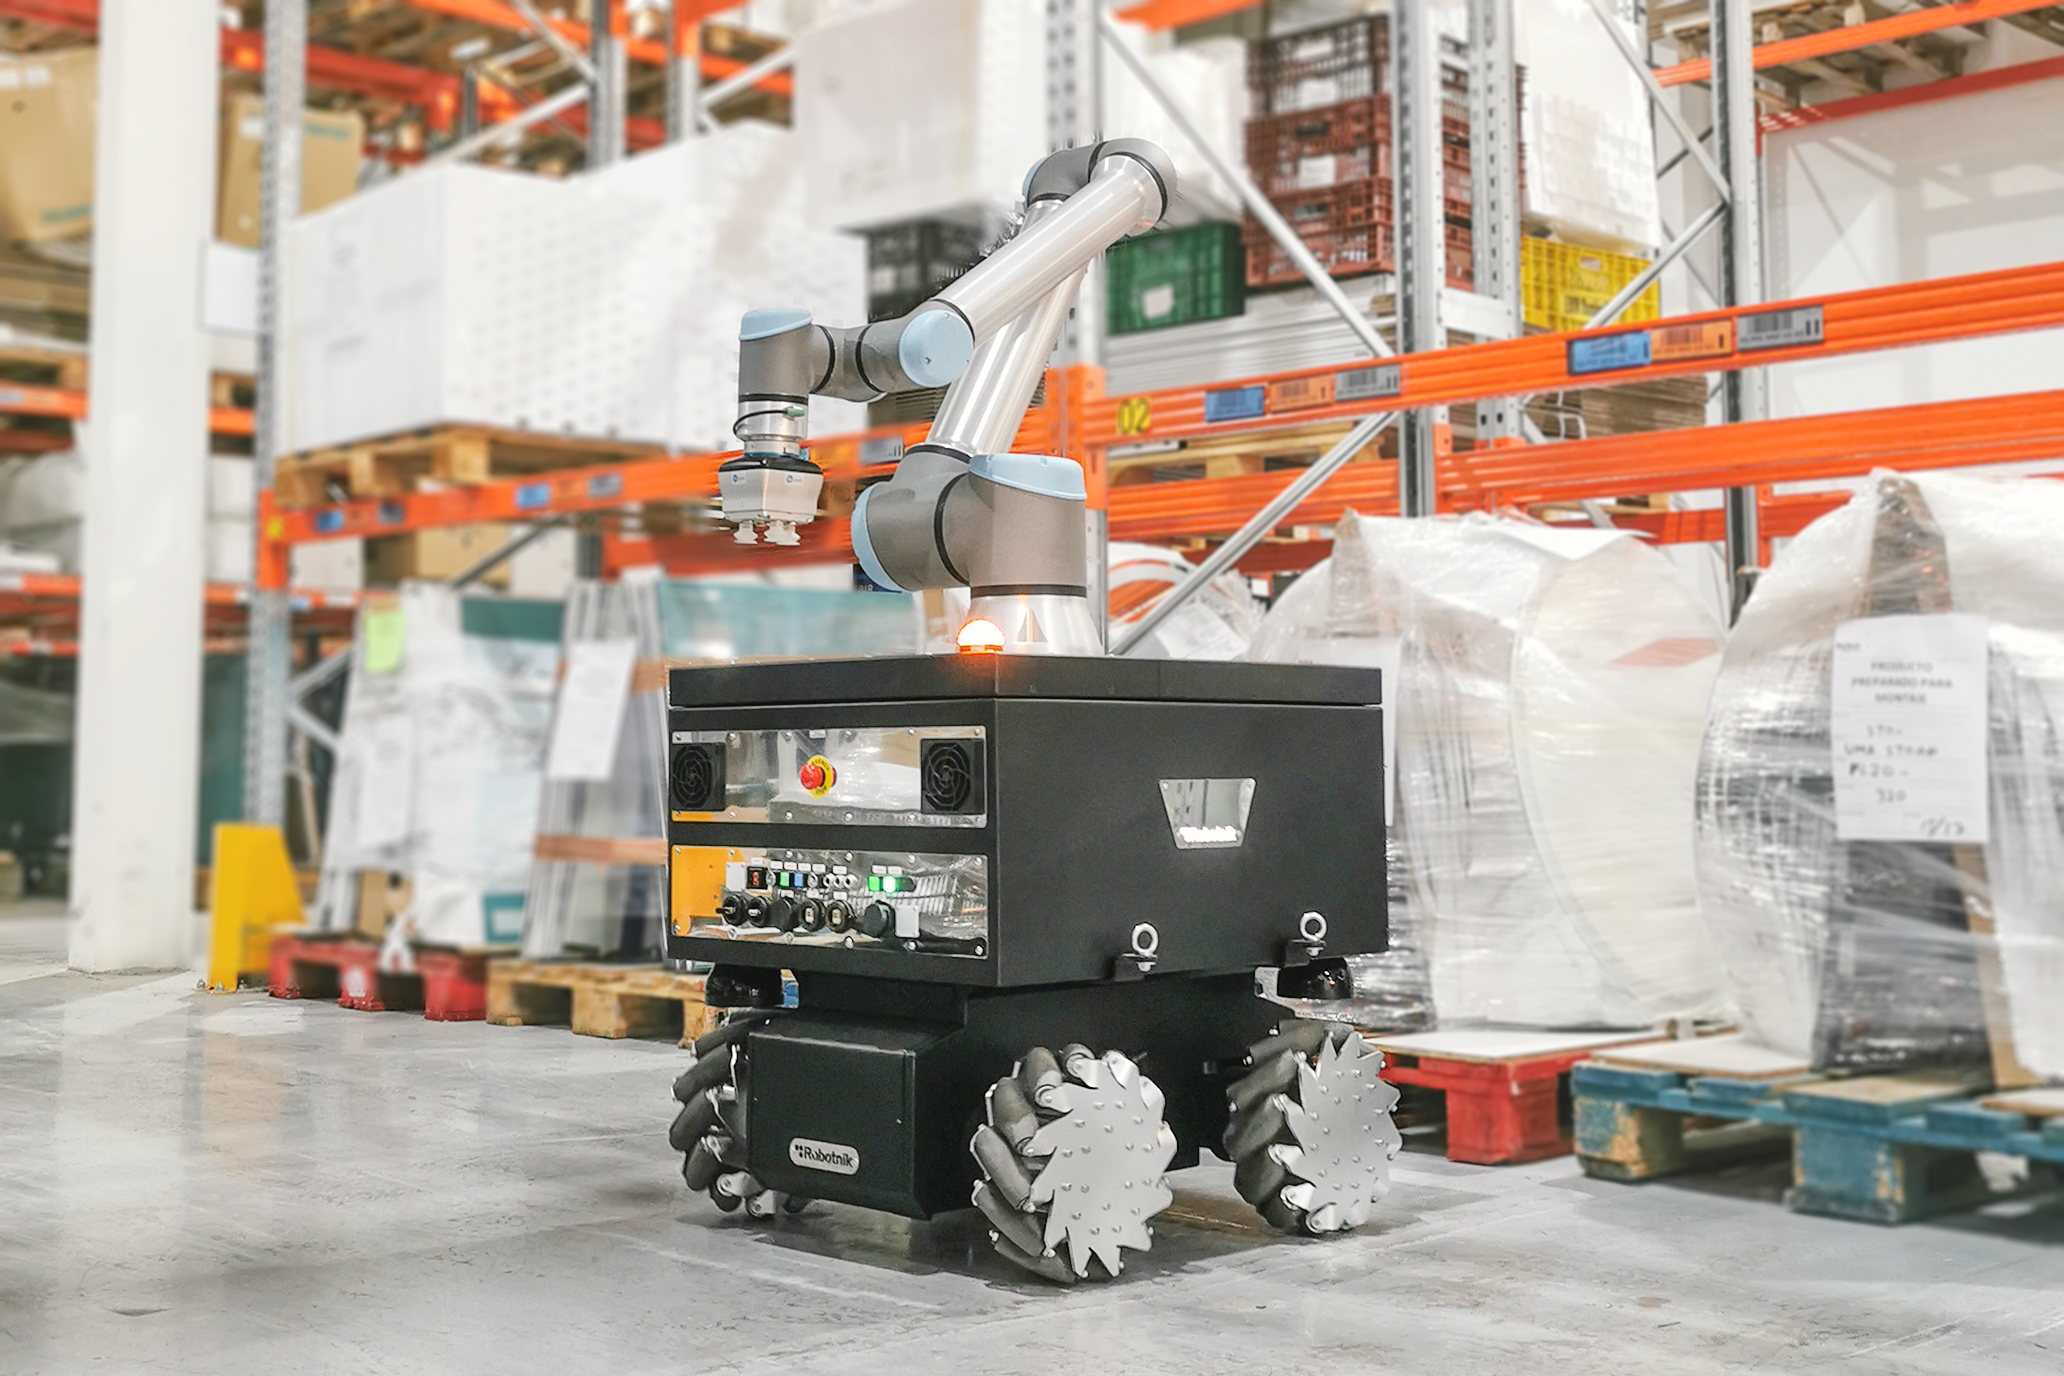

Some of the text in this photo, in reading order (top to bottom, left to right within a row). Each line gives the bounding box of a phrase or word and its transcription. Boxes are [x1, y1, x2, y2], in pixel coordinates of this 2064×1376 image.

[1118, 399, 1149, 434] 02
[1871, 661, 1933, 673] PRODUCTO
[1851, 677, 1953, 689] PREPARADO PARA
[804, 1146, 854, 1168] Robotnik
